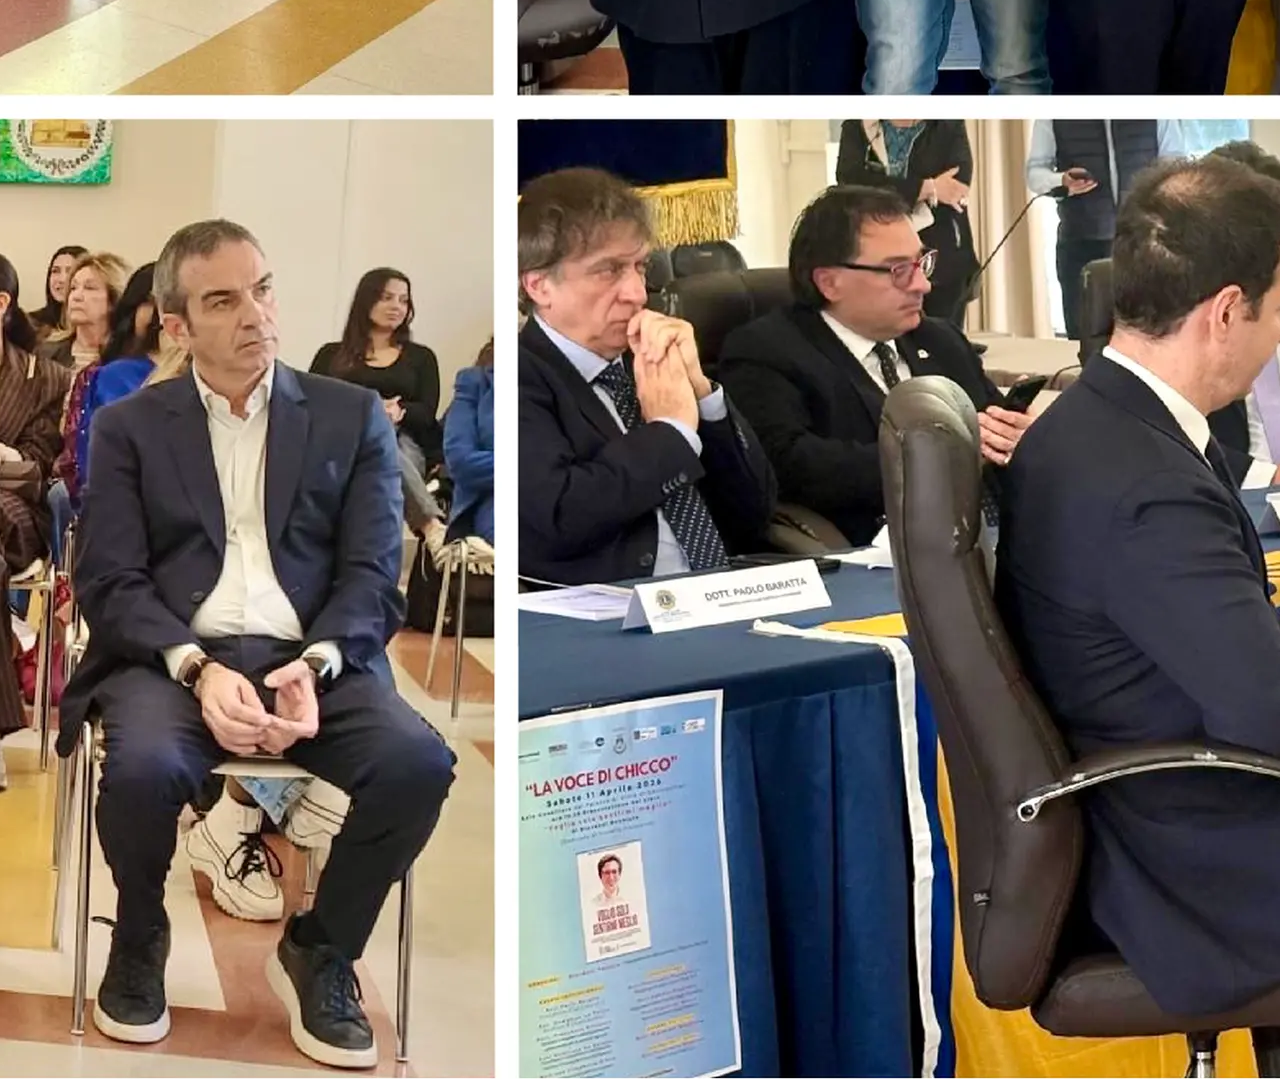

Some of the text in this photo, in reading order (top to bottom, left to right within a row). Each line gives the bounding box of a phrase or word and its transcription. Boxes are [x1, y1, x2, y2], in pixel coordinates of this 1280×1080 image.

[704, 590, 731, 602] DOTT.
[733, 584, 764, 596] PAOLO
[765, 577, 807, 591] BARATTA
[554, 772, 595, 793] VOCE
[598, 768, 611, 784] DI
[546, 795, 582, 808] Sabato
[599, 786, 632, 798] Aprile
